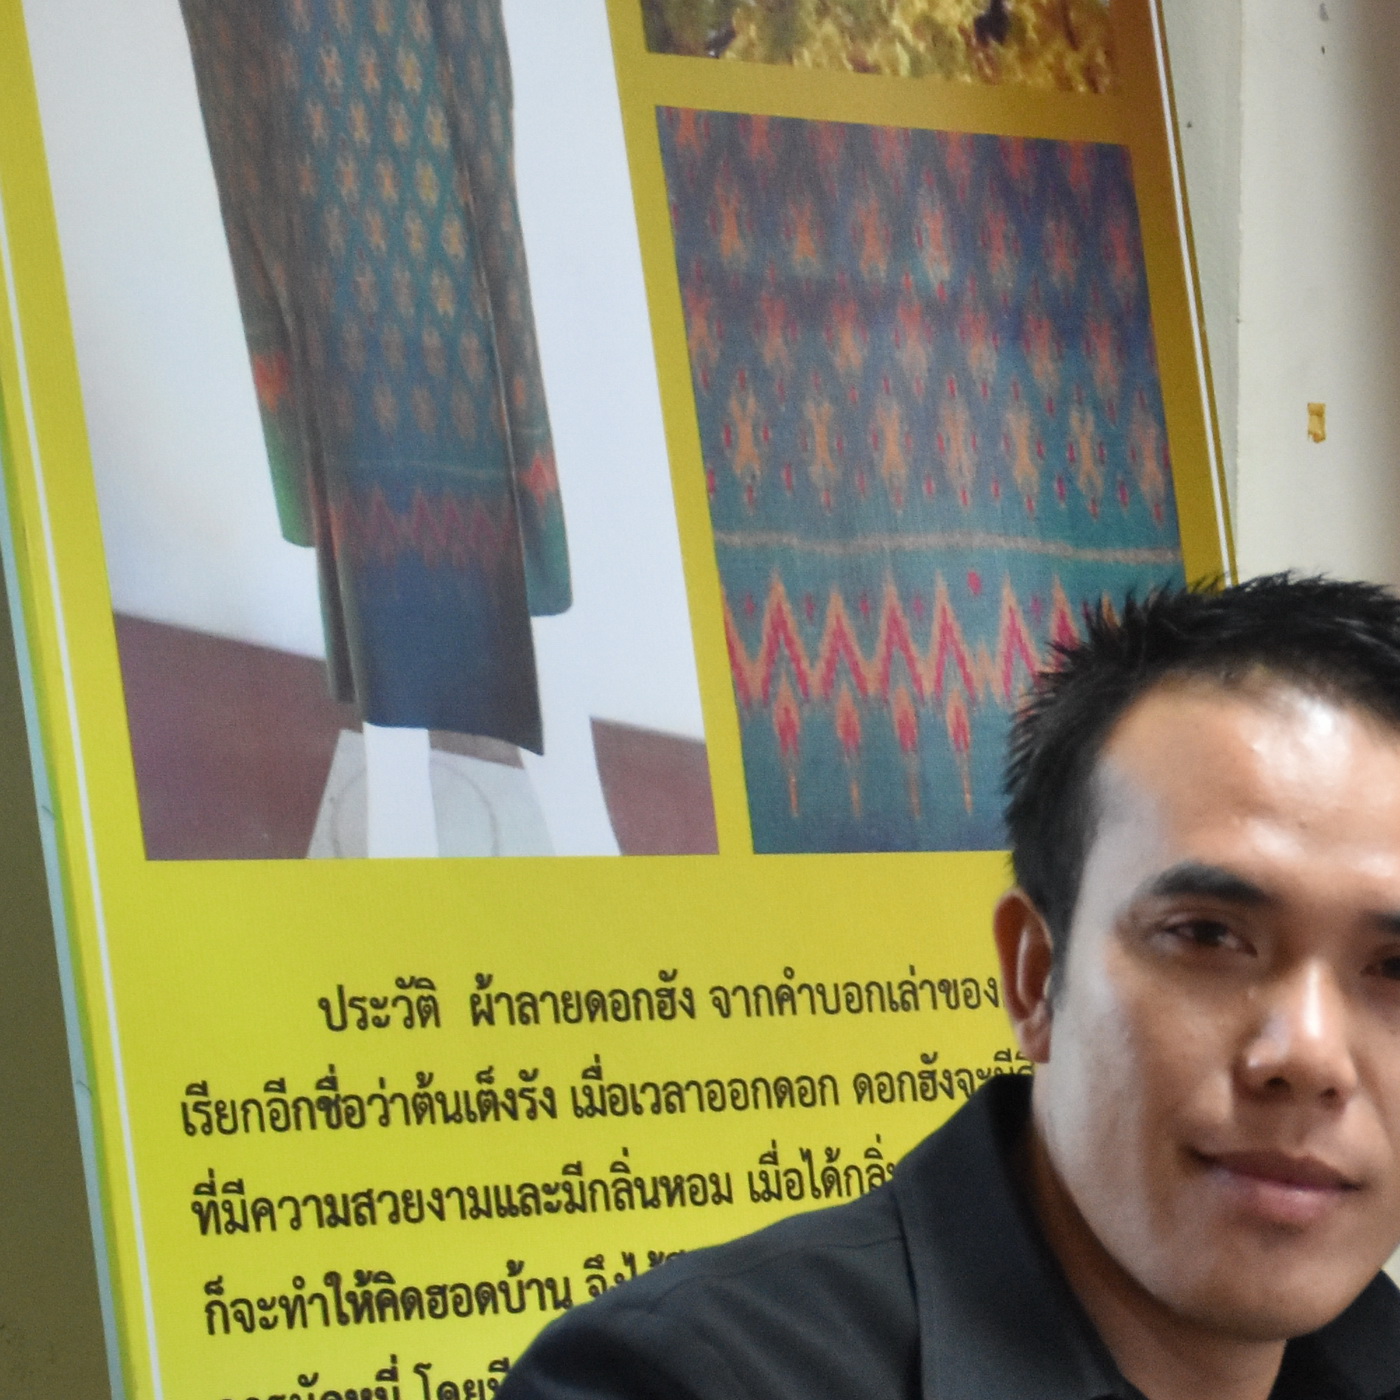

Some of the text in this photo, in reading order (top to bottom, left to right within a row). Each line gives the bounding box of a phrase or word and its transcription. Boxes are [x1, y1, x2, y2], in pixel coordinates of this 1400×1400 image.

[318, 975, 442, 1033] ประวัติ
[469, 968, 697, 1028] ผ้าลายดอกฮัง
[570, 1053, 840, 1120] เมื่อเวลาออกดอก
